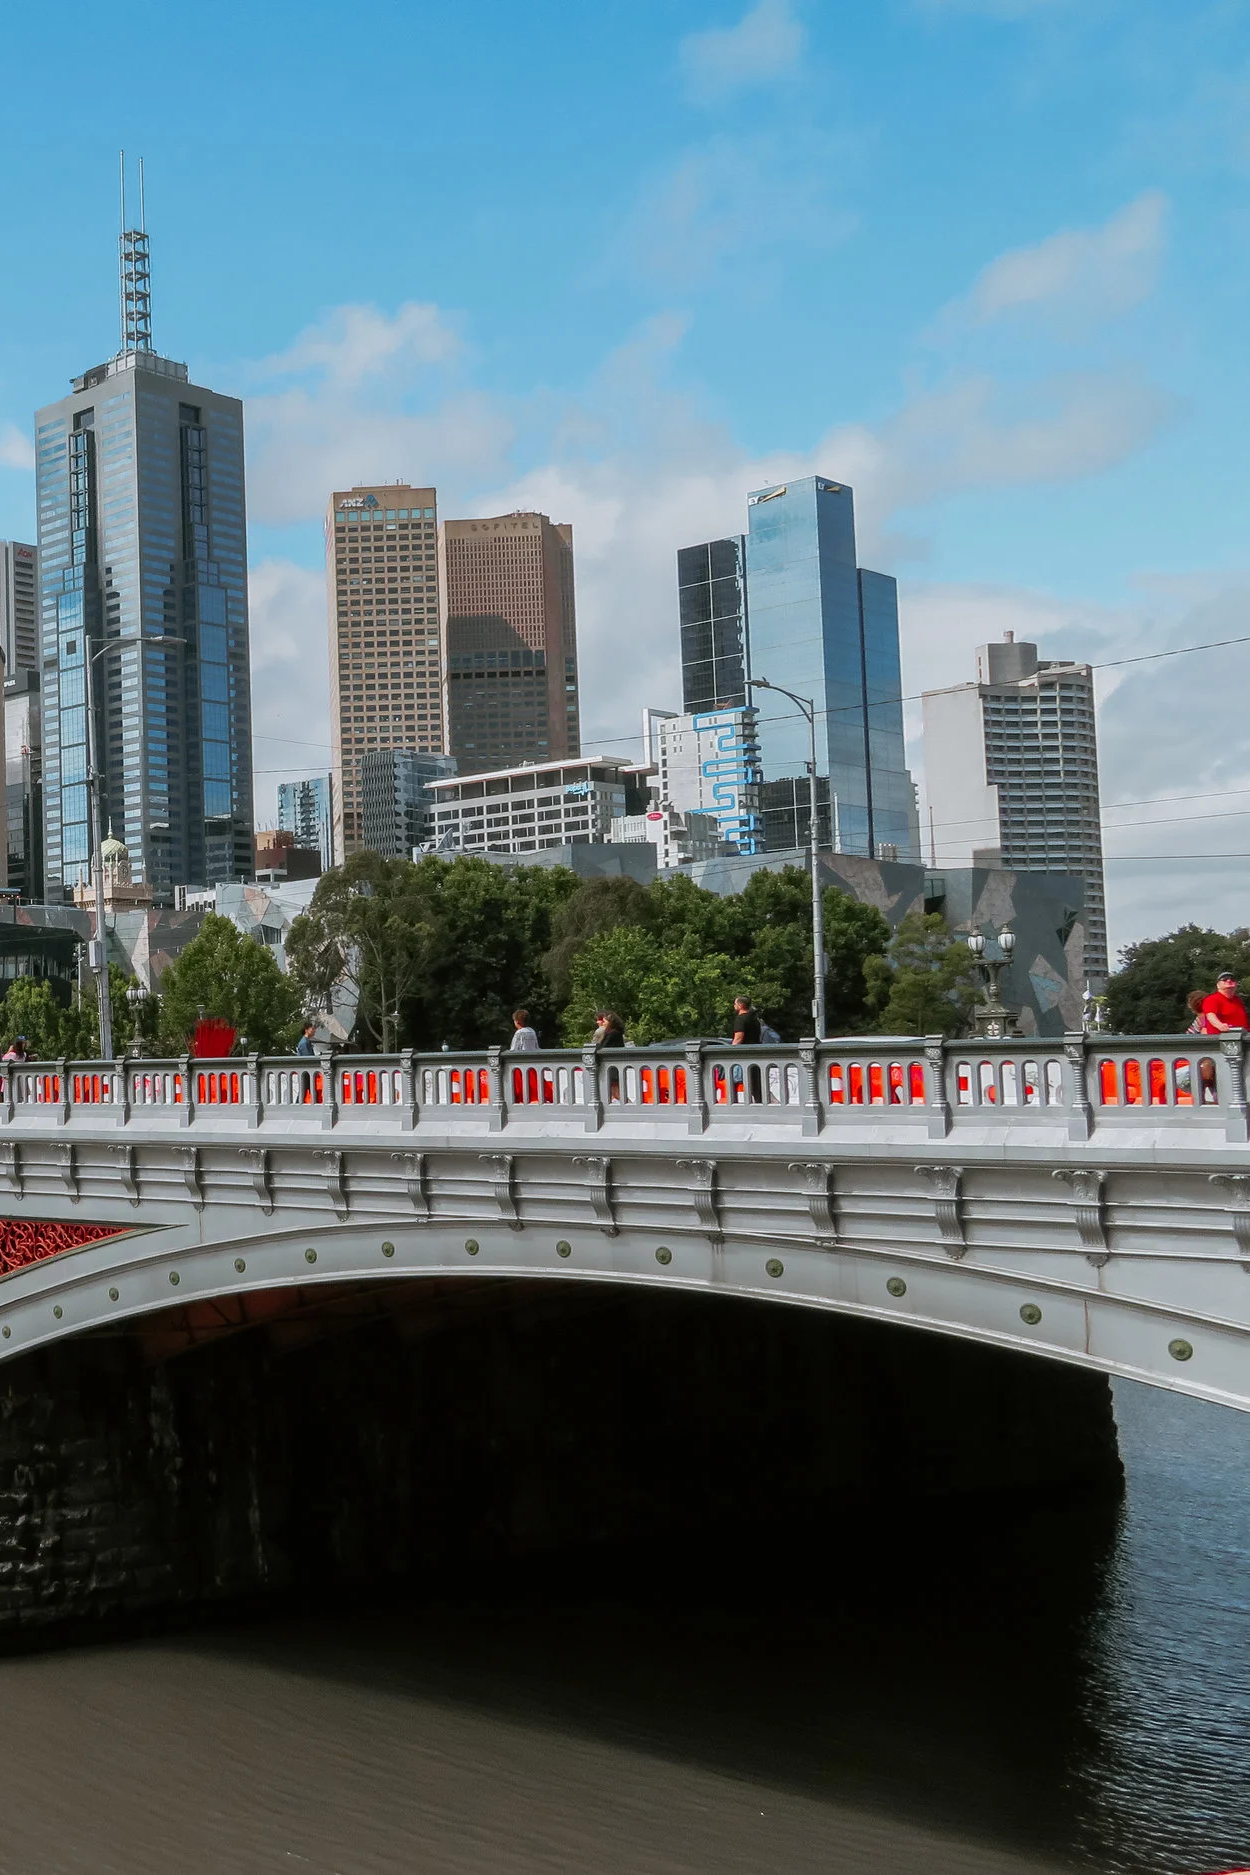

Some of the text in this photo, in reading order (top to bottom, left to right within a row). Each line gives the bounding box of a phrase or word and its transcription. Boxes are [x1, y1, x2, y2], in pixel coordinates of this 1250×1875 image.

[340, 498, 364, 508] ANZ
[748, 495, 760, 506] EY
[470, 522, 539, 532] SOFITEL
